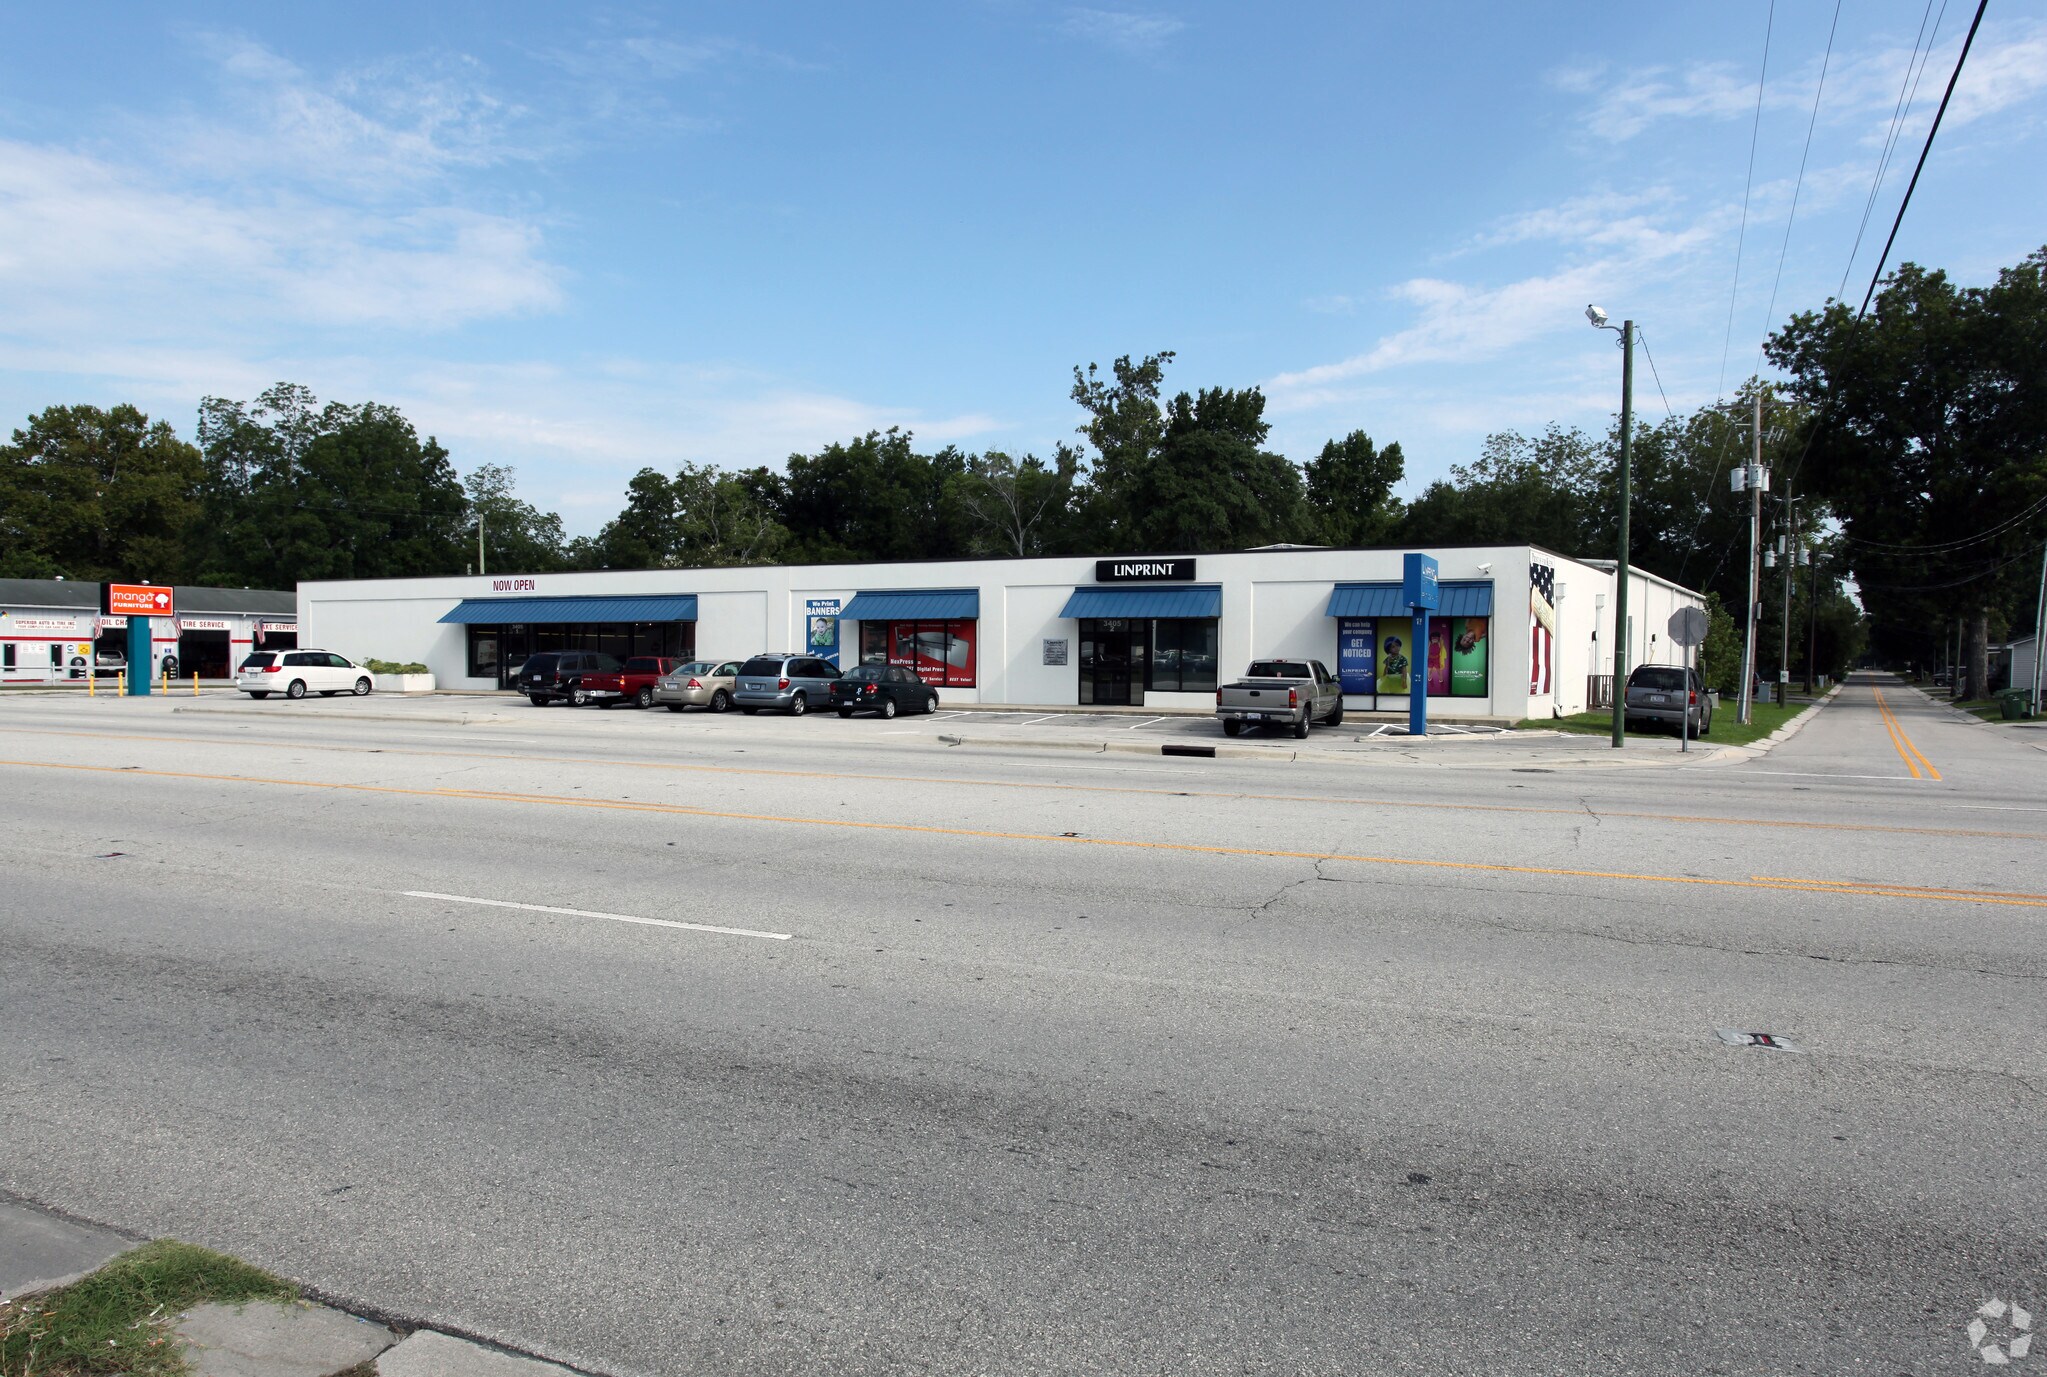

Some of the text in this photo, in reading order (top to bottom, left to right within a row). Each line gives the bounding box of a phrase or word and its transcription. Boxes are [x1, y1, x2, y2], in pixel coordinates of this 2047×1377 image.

[1114, 563, 1174, 576] LINPRINT
[493, 579, 535, 591] NOW OPEN
[113, 592, 154, 603] mango
[806, 607, 840, 615] BANNERS
[1351, 638, 1363, 648] GET
[1342, 648, 1372, 658] NOTICED
